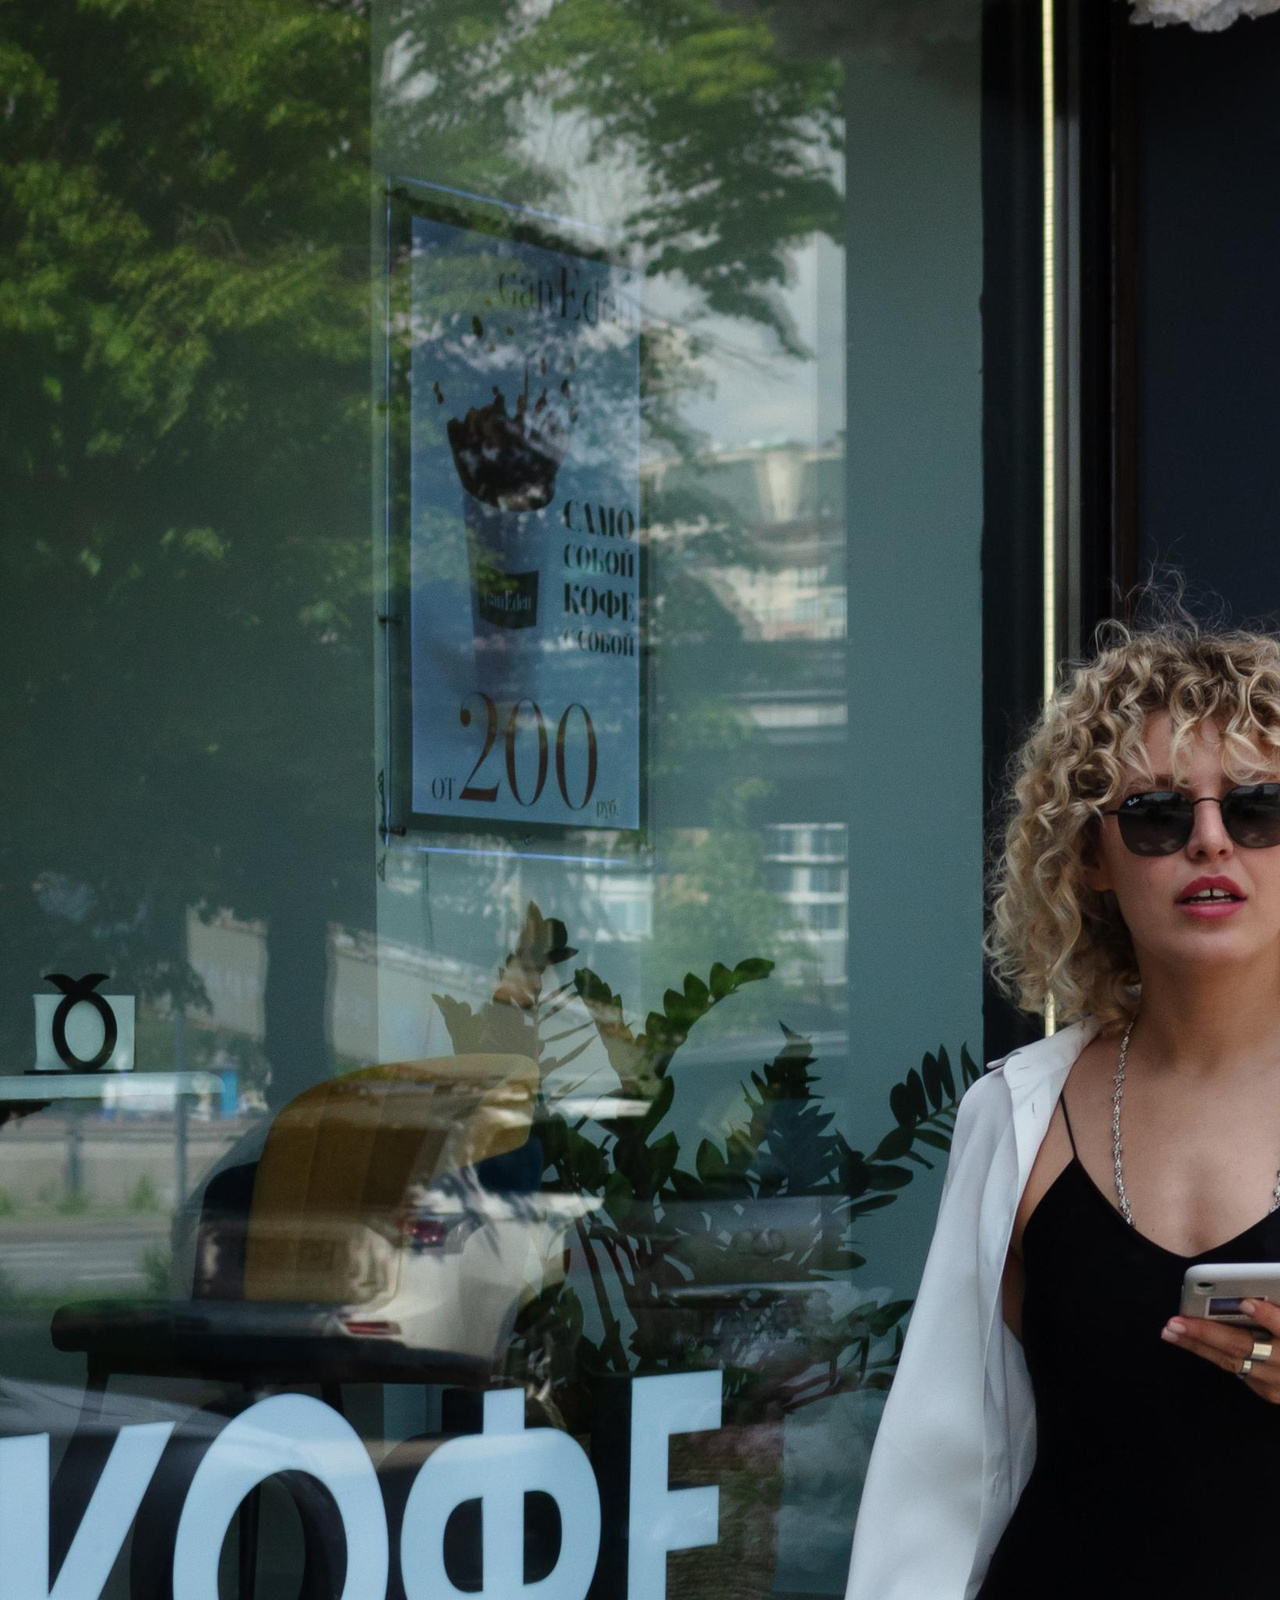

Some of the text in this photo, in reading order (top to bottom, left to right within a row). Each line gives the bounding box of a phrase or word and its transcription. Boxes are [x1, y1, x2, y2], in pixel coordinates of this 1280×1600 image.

[563, 499, 635, 540] САМО
[563, 543, 634, 578] СОБОЙ
[563, 582, 635, 622] КОФЕ
[459, 691, 598, 811] 200
